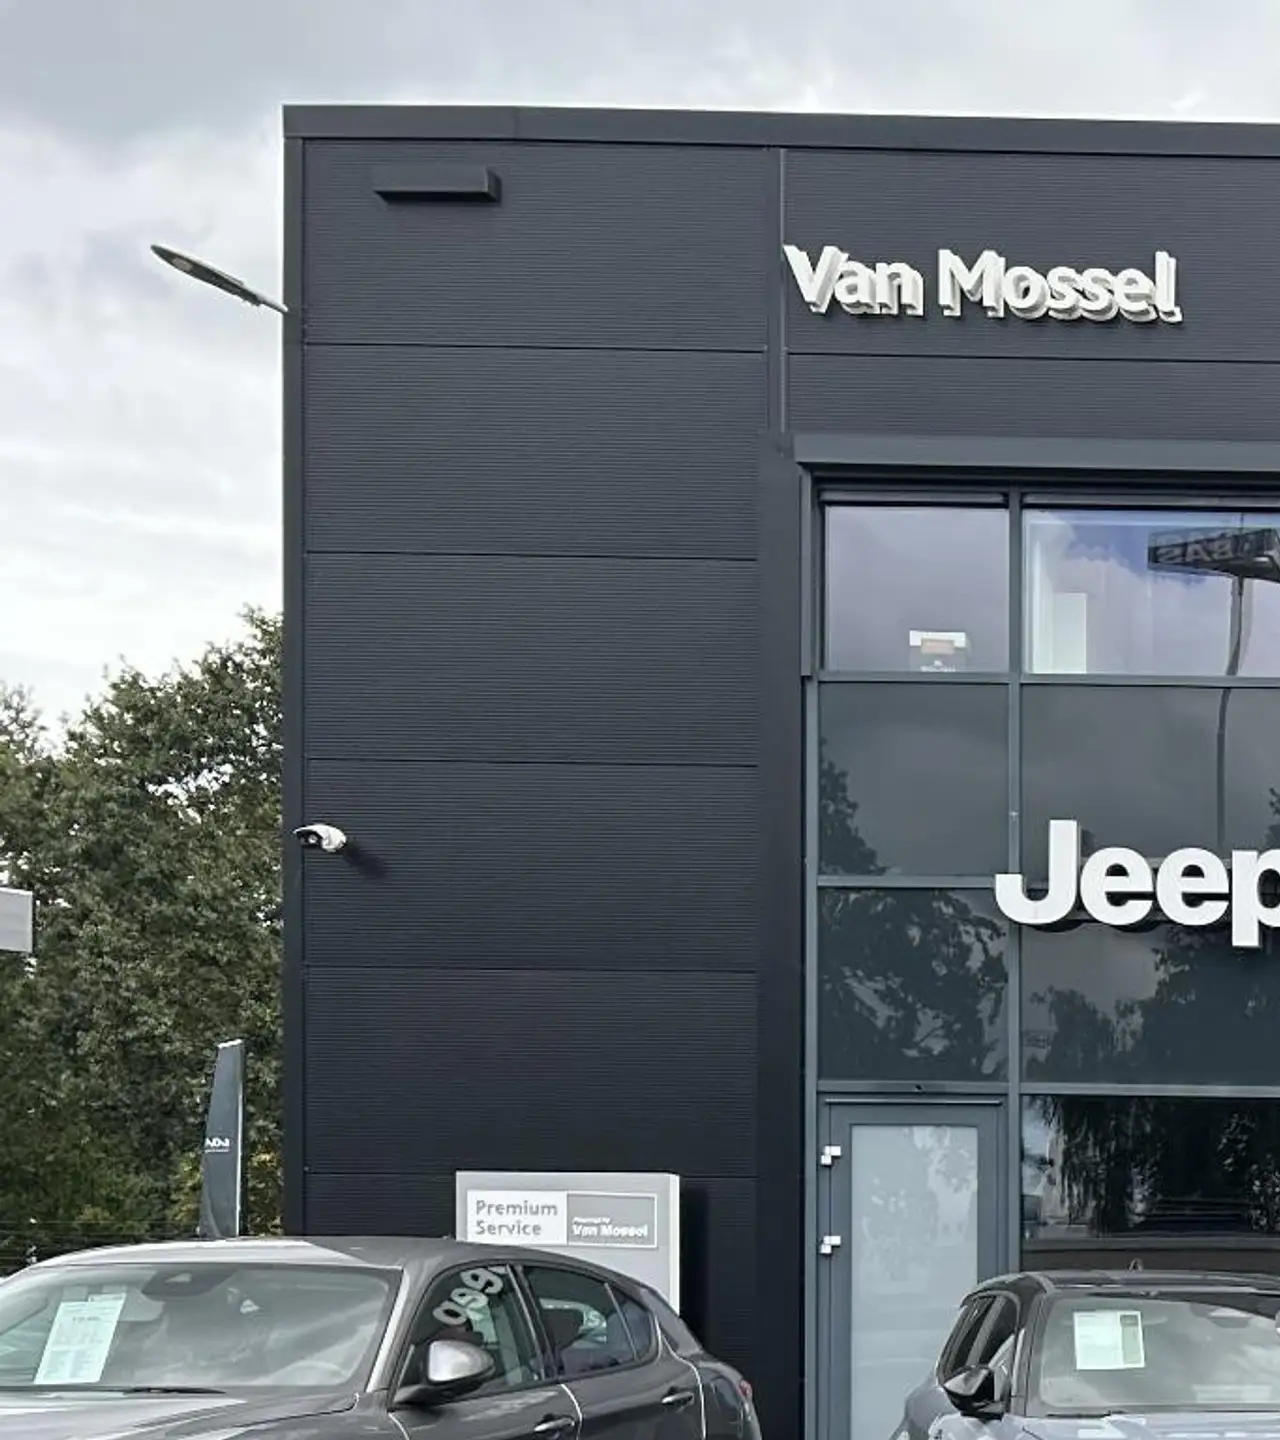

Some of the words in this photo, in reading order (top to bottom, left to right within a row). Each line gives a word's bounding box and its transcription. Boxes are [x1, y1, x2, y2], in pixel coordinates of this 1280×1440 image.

[783, 245, 924, 316] Van
[938, 248, 1184, 322] Mossel
[475, 1200, 559, 1216] Premium
[475, 1221, 542, 1236] Service
[572, 1225, 597, 1237] Van
[601, 1225, 649, 1238] Mossel
